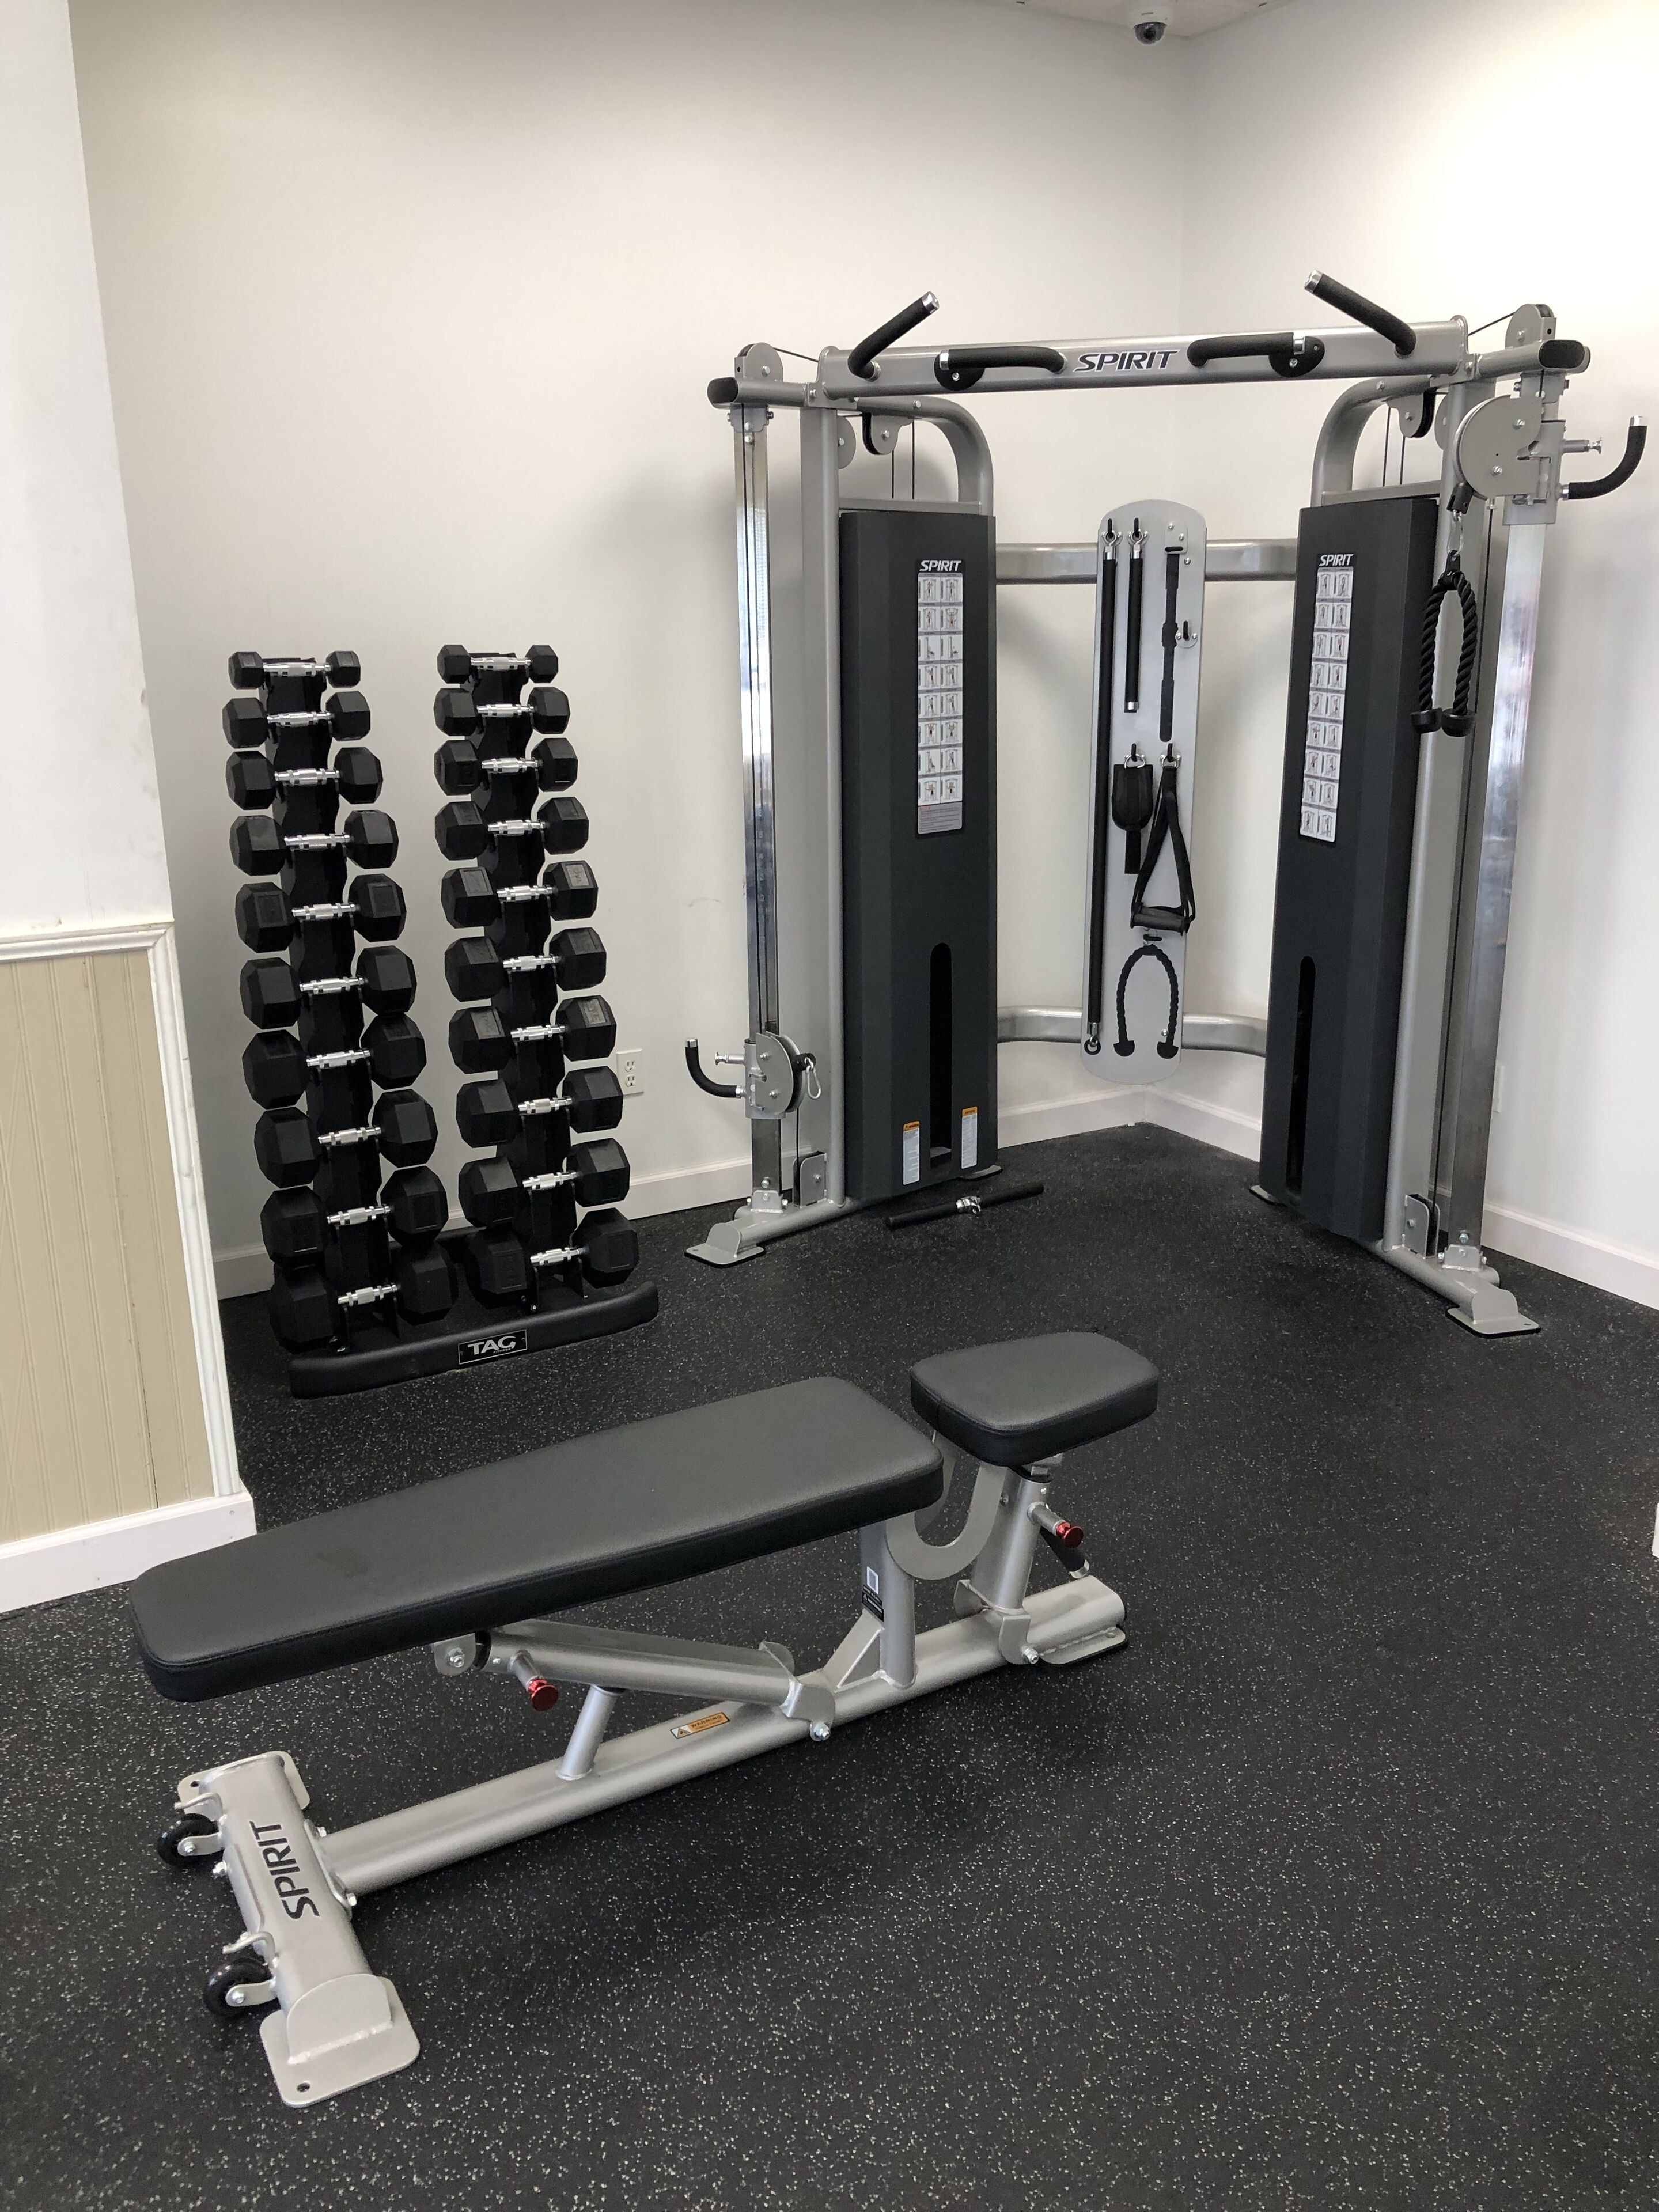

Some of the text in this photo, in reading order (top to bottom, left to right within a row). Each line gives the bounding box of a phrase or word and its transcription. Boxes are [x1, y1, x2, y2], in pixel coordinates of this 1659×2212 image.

[1074, 350, 1179, 372] SPIRIT
[919, 560, 961, 572] SPIRIT
[1319, 554, 1354, 567] SPIRIT
[467, 1335, 516, 1355] TAG
[249, 1821, 320, 1920] SPIRIT
